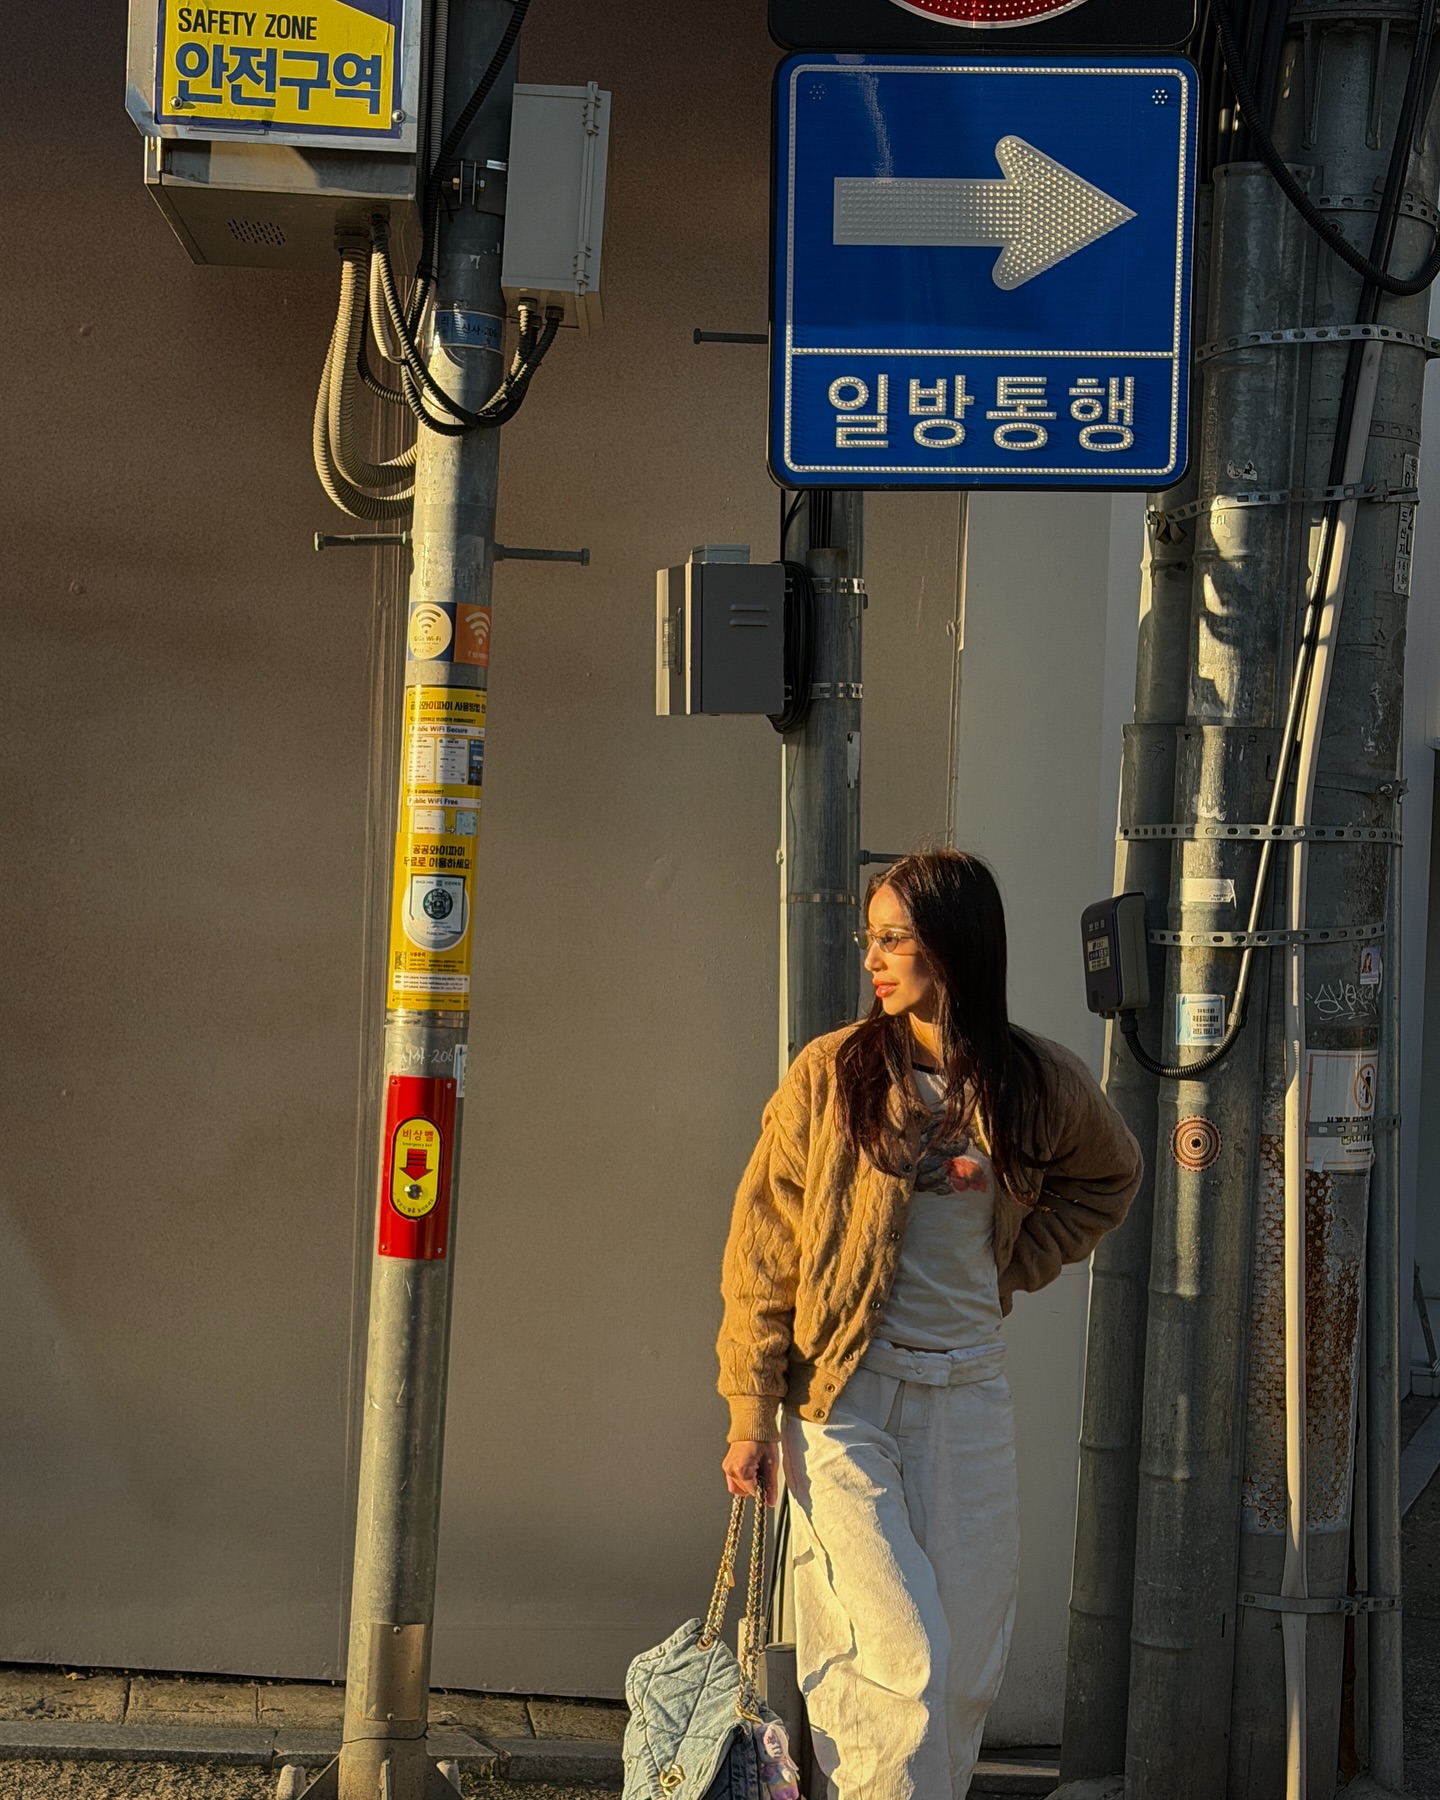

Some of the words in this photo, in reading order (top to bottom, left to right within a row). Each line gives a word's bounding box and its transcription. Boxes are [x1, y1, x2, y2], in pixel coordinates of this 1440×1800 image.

[178, 8, 257, 37] SAFETY
[264, 14, 317, 40] ZONE
[175, 41, 382, 115] 안전구역
[828, 373, 1135, 452] 일방통행
[410, 700, 453, 711] 공와이파이
[429, 725, 445, 733] WiFi
[446, 726, 468, 735] Secure
[427, 797, 443, 805] WiFi
[444, 798, 459, 806] Free
[413, 844, 466, 857] 공공와이파이
[402, 1128, 434, 1142] 비상벨
